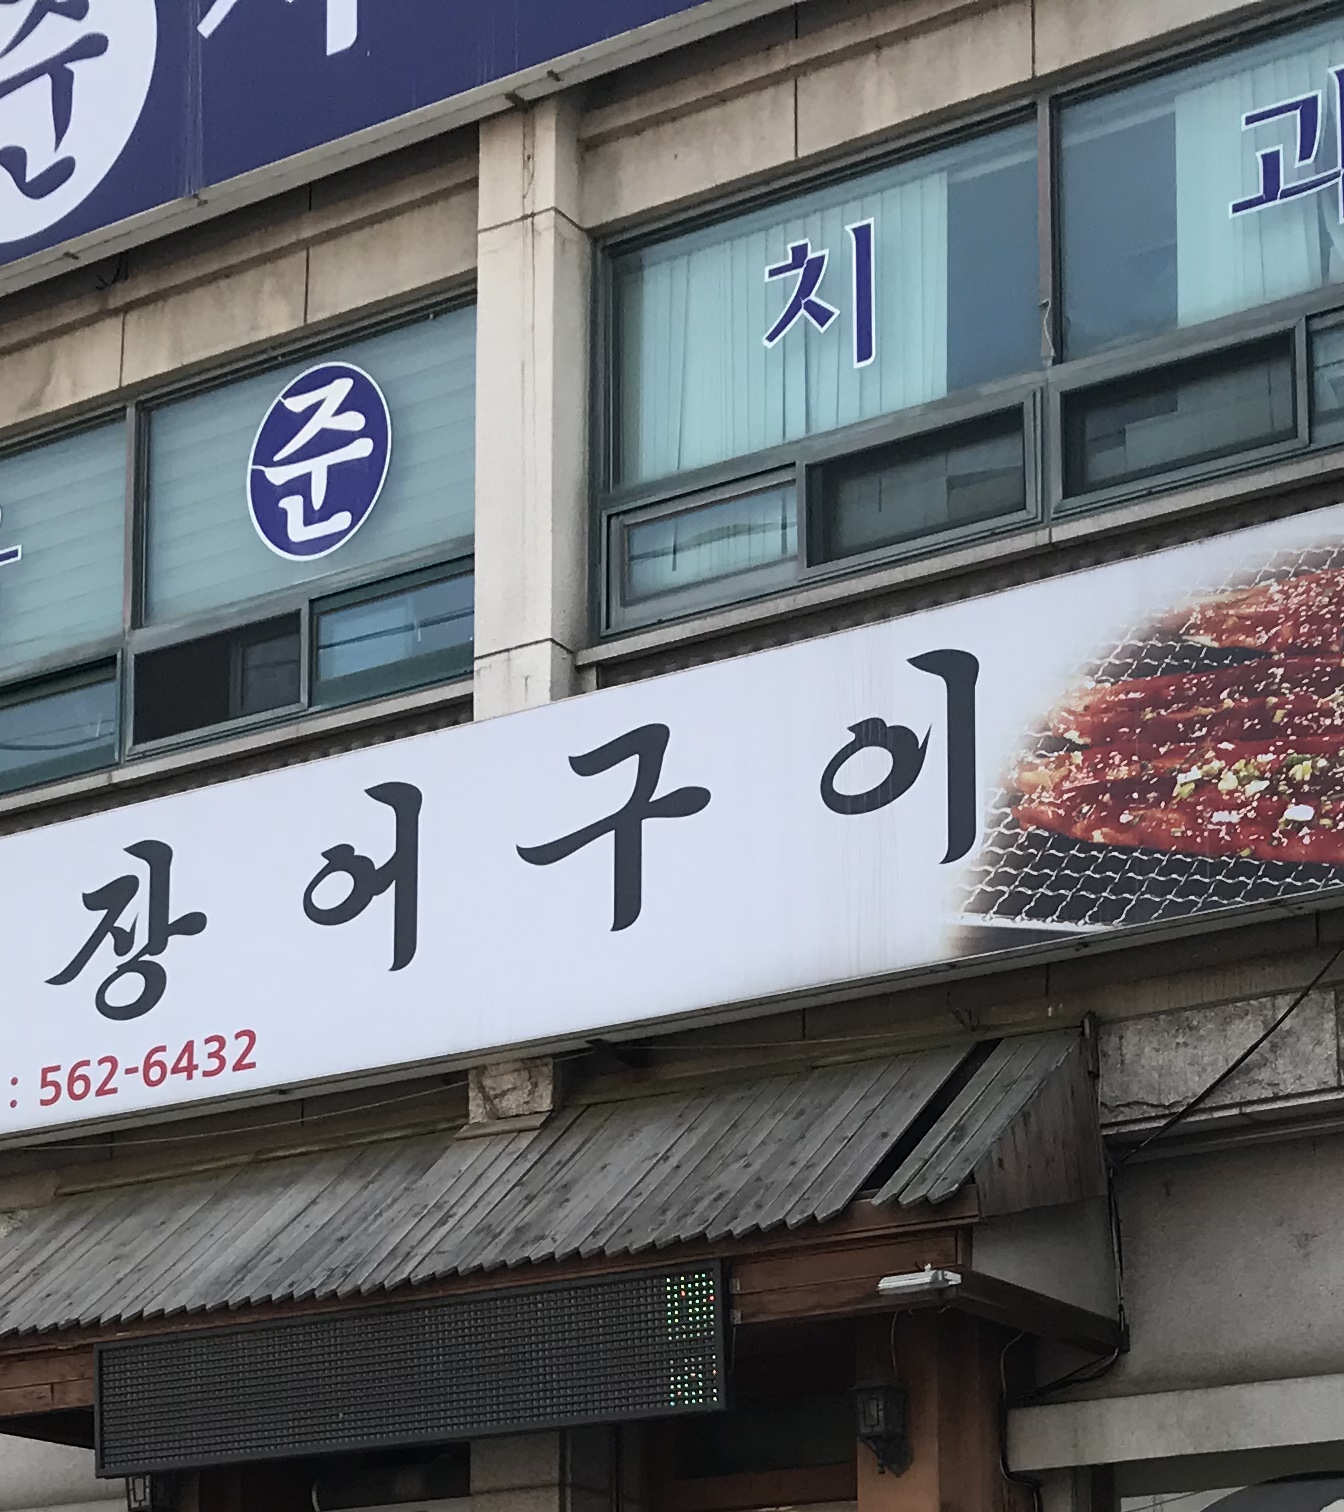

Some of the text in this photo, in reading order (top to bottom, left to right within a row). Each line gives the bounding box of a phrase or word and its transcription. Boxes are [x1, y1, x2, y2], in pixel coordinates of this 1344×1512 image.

[266, 377, 373, 541] 준
[762, 217, 876, 369] 치
[39, 1027, 258, 1107] 562-6432
